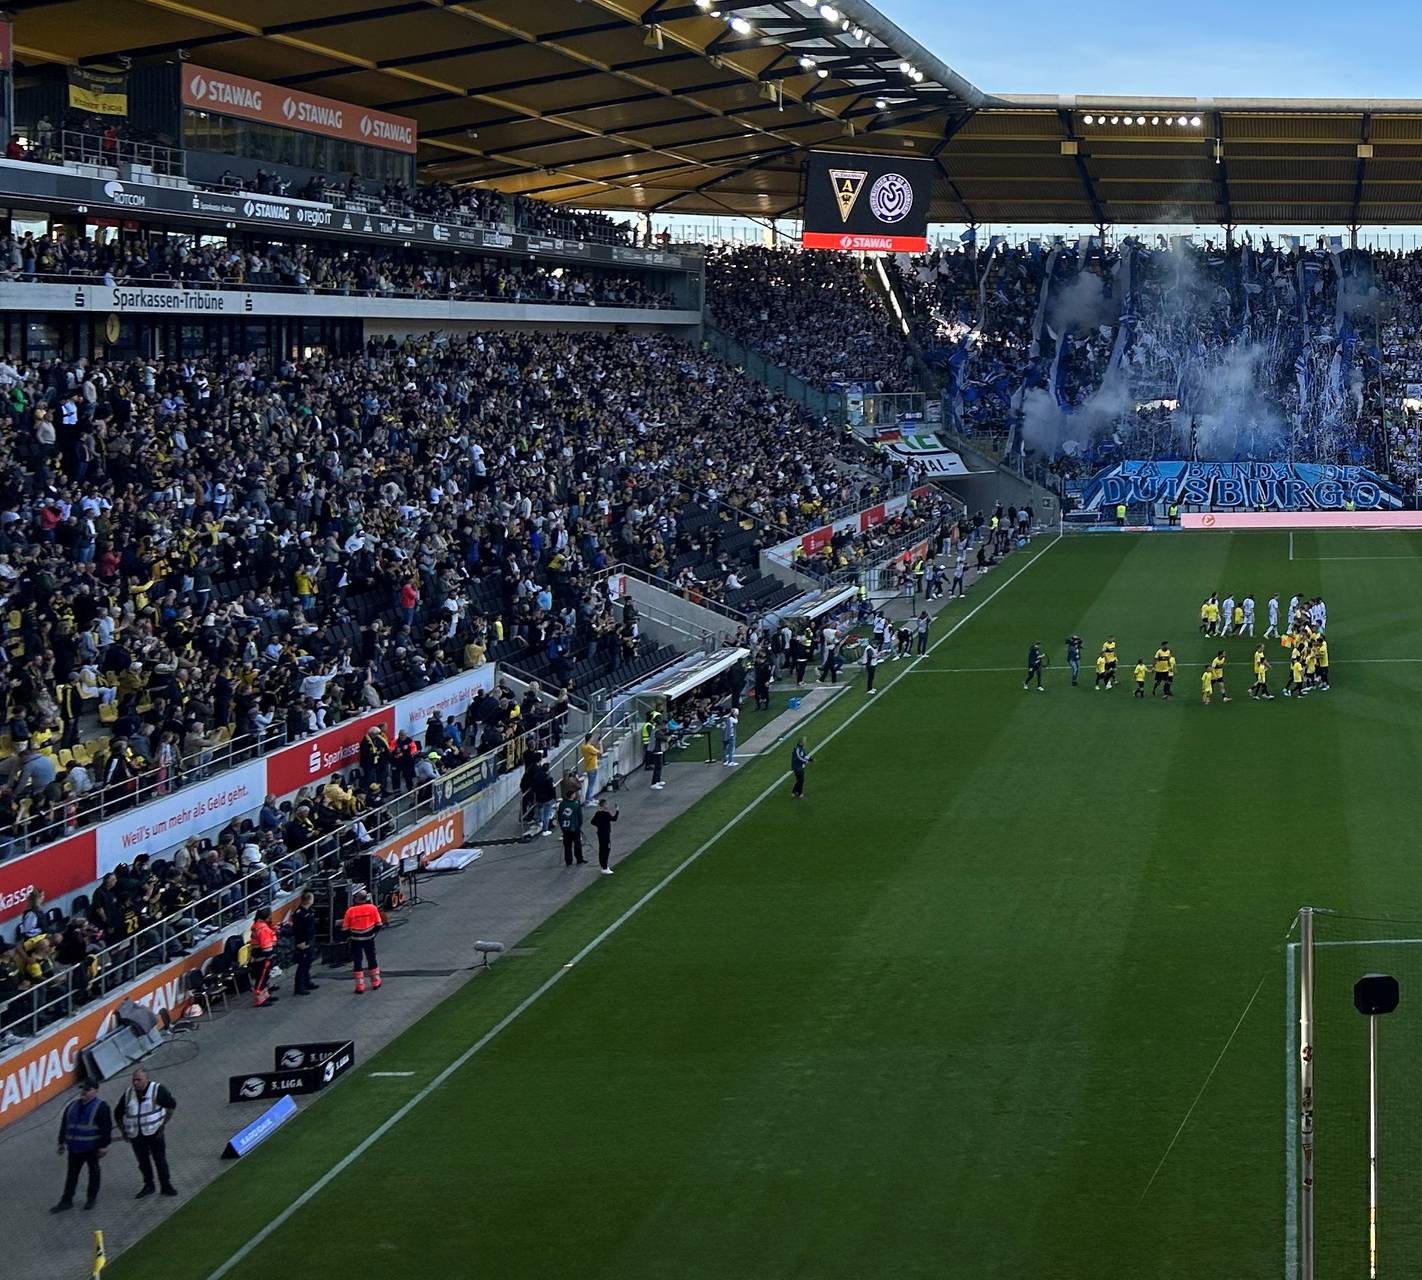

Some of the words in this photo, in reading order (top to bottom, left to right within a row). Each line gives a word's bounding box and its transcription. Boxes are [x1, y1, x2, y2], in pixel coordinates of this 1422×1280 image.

[208, 80, 262, 111] STAWAG
[298, 102, 343, 129] STAWAG
[373, 119, 412, 145] STAWAG
[842, 180, 854, 192] A
[255, 203, 290, 221] STAWAG
[853, 238, 893, 249] STAWAG
[113, 288, 224, 312] Sparkassen-Tribüne
[1119, 460, 1161, 478] LA
[1187, 462, 1296, 481] BANDA
[1319, 465, 1362, 483] DE
[1100, 476, 1382, 509] DUISBURGO
[323, 742, 360, 768] Sparkasse
[121, 825, 151, 849] Weil's
[152, 819, 168, 836] um
[168, 807, 192, 828] mehr
[193, 802, 206, 818] als
[207, 791, 227, 812] Geld
[227, 785, 249, 807] geht.
[271, 1080, 280, 1090] 3.
[281, 1078, 303, 1089] LIGA
